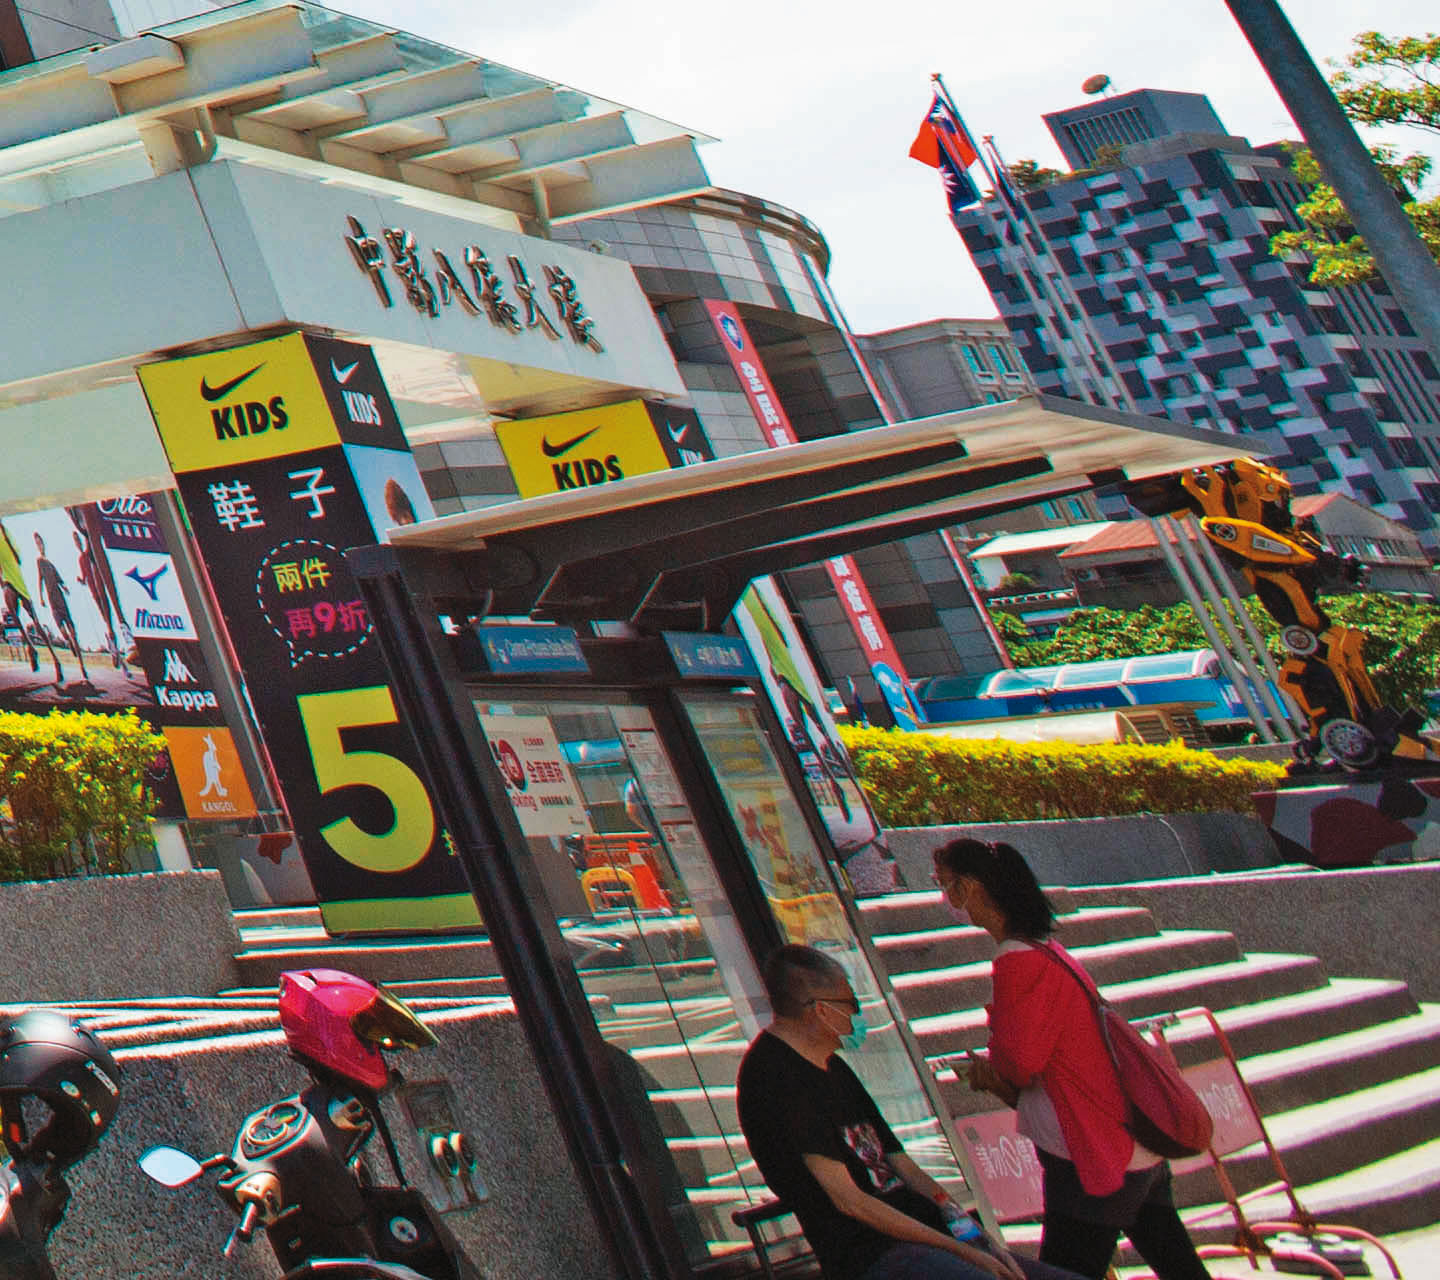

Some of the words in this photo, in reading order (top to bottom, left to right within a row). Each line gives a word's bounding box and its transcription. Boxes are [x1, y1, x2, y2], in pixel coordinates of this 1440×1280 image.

[210, 396, 288, 440] KIDS
[341, 390, 382, 428] KIDS
[552, 454, 624, 491] KIDS
[208, 466, 336, 533] 鞋子
[272, 558, 332, 594] 兩件
[154, 685, 217, 712] Kappa
[296, 684, 436, 873] 5
